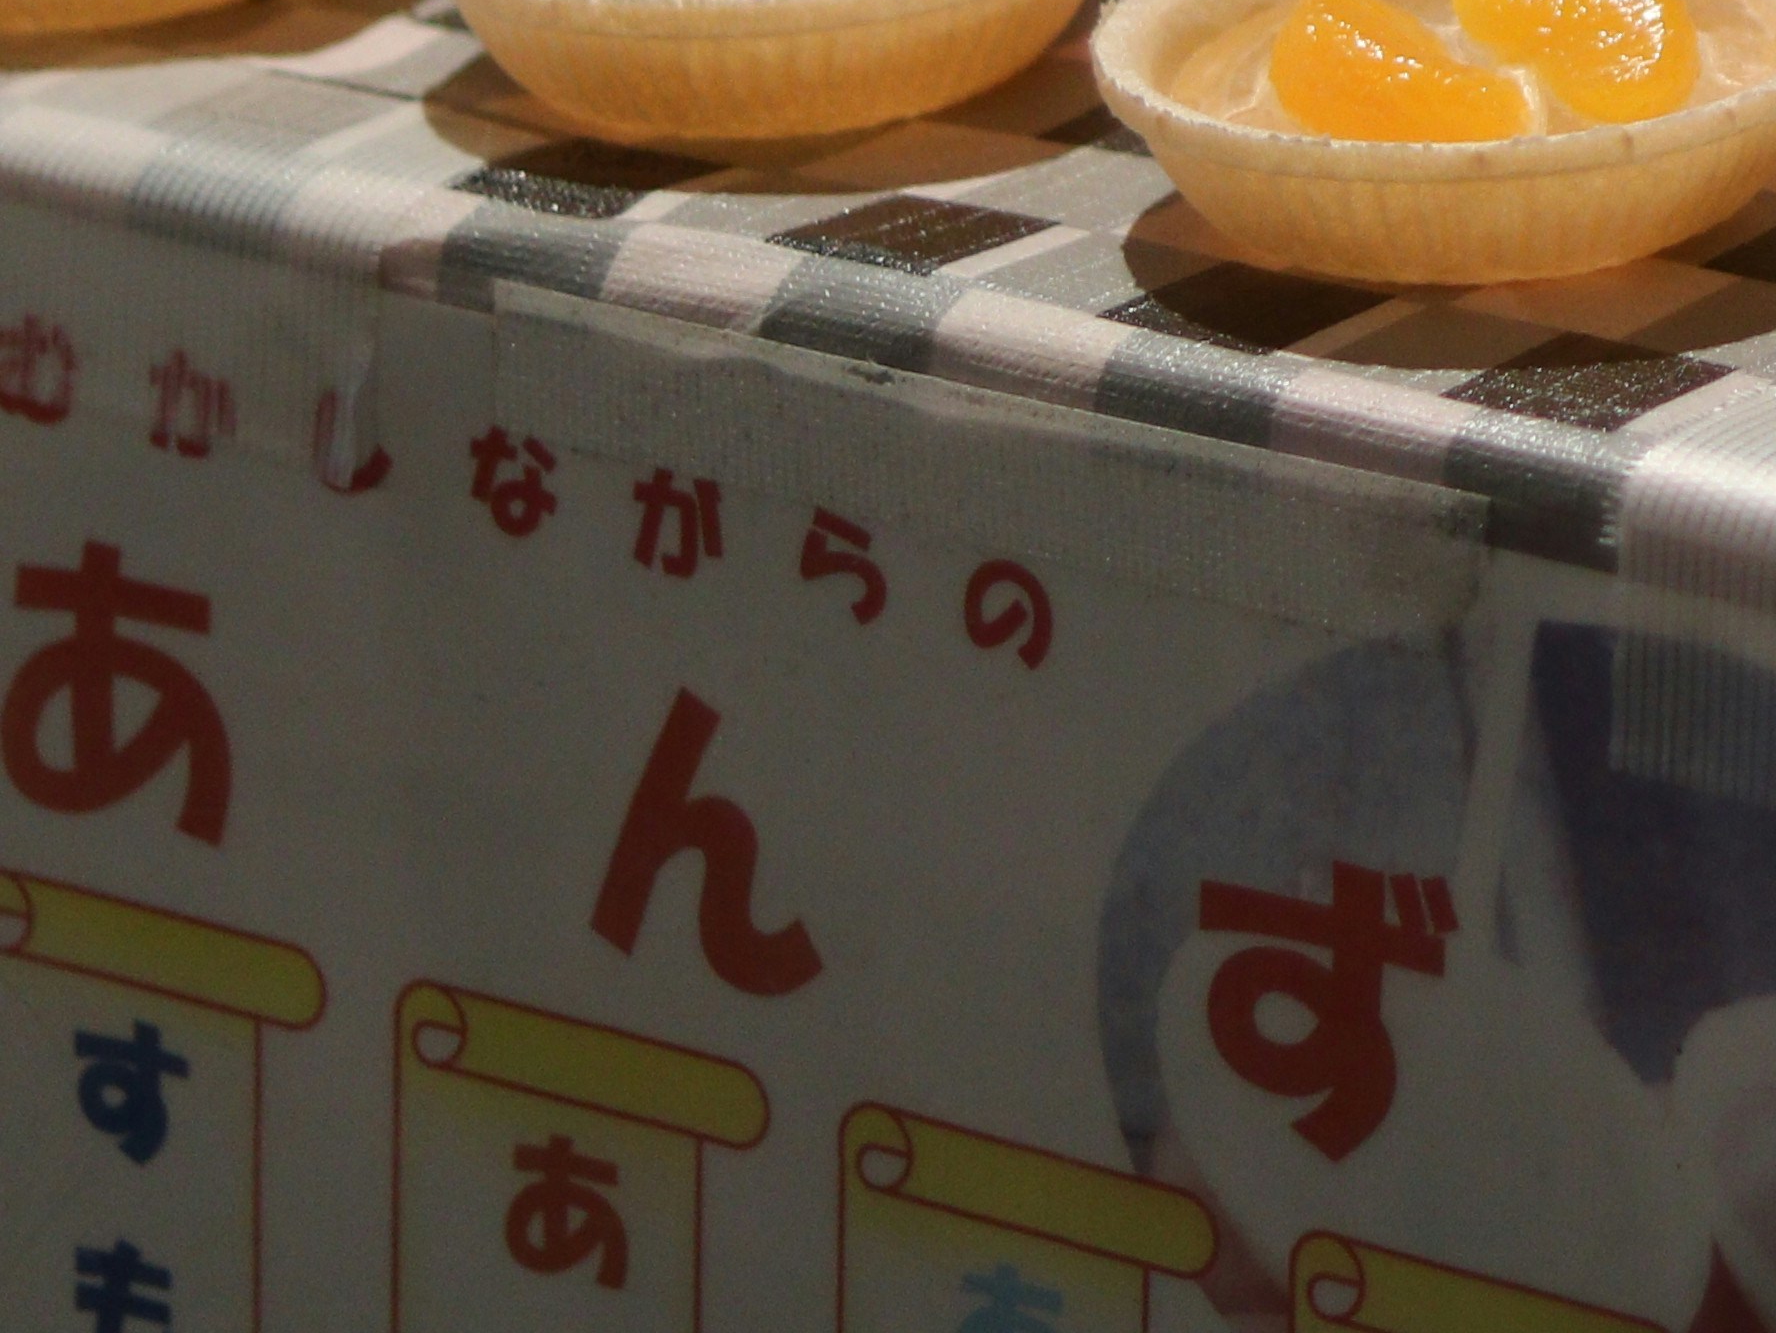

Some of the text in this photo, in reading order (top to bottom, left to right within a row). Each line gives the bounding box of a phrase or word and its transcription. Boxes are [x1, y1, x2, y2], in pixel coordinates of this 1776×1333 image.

[0, 312, 1054, 671] むかしながらの
[505, 1135, 629, 1290] あ
